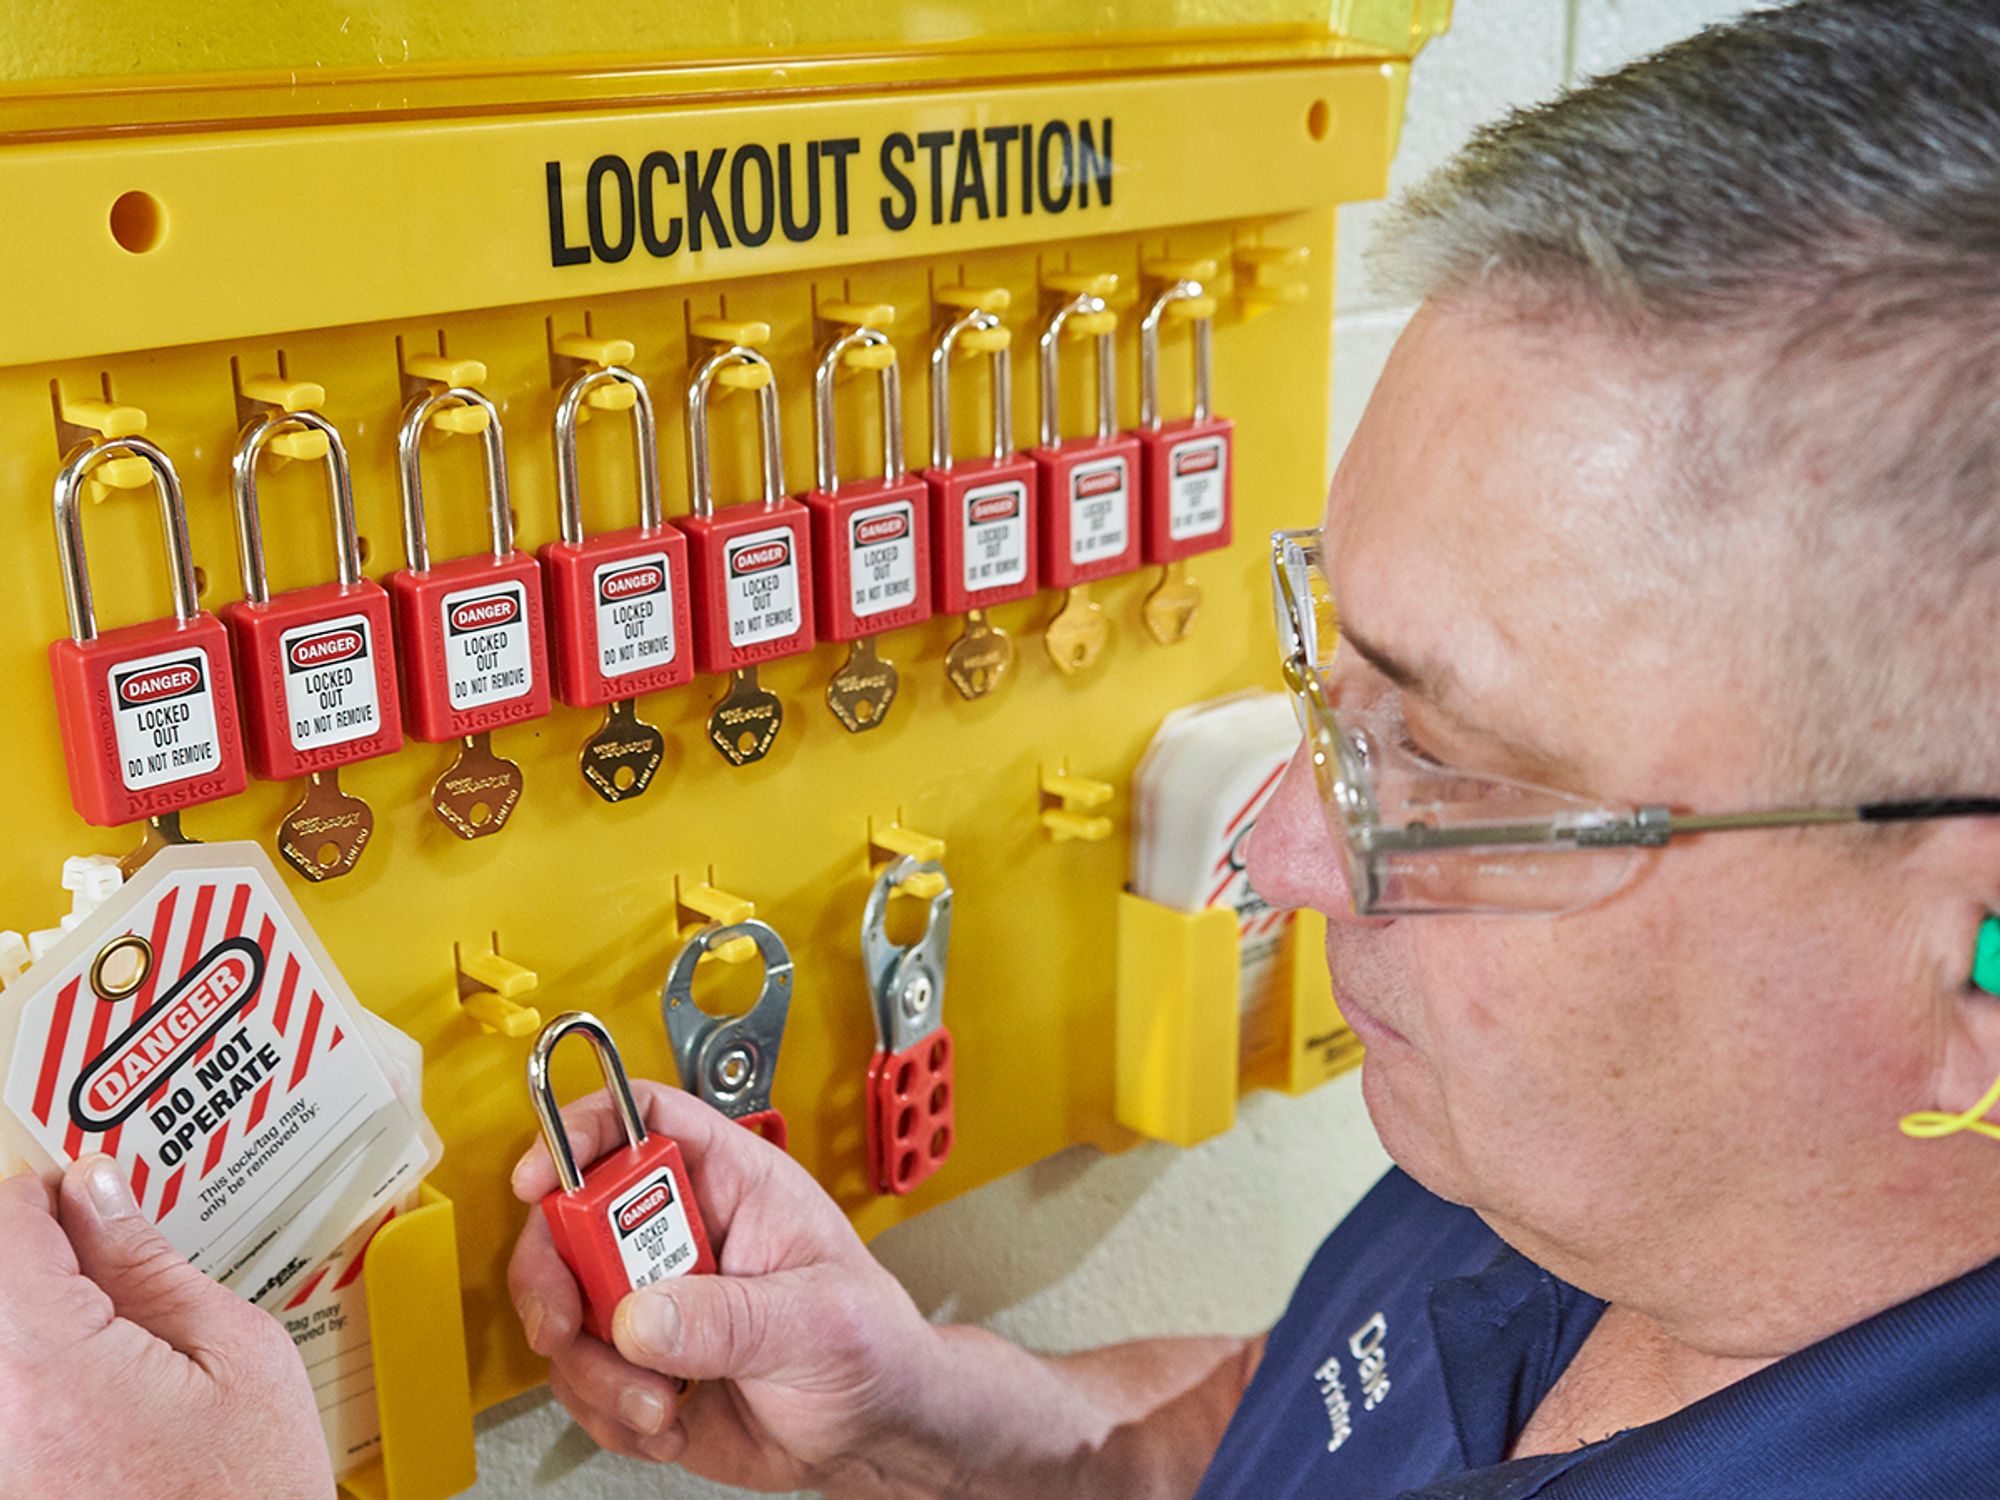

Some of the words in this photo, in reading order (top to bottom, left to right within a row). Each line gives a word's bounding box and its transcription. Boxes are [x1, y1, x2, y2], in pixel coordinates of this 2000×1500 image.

[545, 138, 860, 267] LOCKOUT
[880, 118, 1113, 231] STATION
[737, 547, 784, 568] DANGER
[607, 572, 657, 595] DANGER
[742, 574, 780, 597] LOCKED
[458, 602, 512, 625] DANGER
[613, 601, 654, 625] LOCKED
[752, 593, 772, 611] OUT
[624, 620, 646, 640] OUT
[734, 620, 745, 636] DO
[748, 615, 762, 633] NOT
[765, 608, 794, 628] REMOVE
[298, 637, 356, 661] DANGER
[464, 632, 509, 657] LOCKED
[604, 650, 616, 666] DO
[619, 644, 635, 662] NOT
[637, 635, 669, 657] REMOVE
[476, 652, 499, 672] OUT
[129, 671, 192, 697] DANGER
[305, 667, 353, 694] LOCKED
[455, 681, 467, 698] DO
[471, 676, 489, 695] NOT
[491, 668, 525, 690] REMOVE
[601, 668, 679, 698] Master
[319, 689, 344, 710] OUT
[137, 703, 190, 731] LOCKED
[296, 720, 310, 738] DO
[314, 715, 333, 734] NOT
[336, 704, 373, 728] REMOVE
[452, 701, 535, 732] Master
[153, 725, 180, 747] OUT
[129, 760, 143, 777] DO
[148, 753, 168, 772] NOT
[173, 742, 213, 766] REMOVE
[294, 737, 385, 770] Master
[126, 779, 226, 815] Master
[93, 966, 240, 1108] DANGER
[150, 1087, 195, 1135] DO
[195, 1027, 253, 1091] NOT
[158, 1042, 282, 1168] OPERATE
[198, 1176, 228, 1203] This
[227, 1126, 280, 1177] lock/tag
[278, 1098, 306, 1128] may
[200, 1194, 227, 1222] only
[227, 1176, 246, 1195] be
[246, 1122, 300, 1177] removed
[299, 1102, 321, 1124] by:
[623, 1190, 666, 1226] DANGER
[633, 1217, 670, 1251] LOCKED
[647, 1237, 667, 1261] OUT
[663, 1243, 690, 1271] REMOVE
[286, 1316, 309, 1332] /tag
[313, 1304, 340, 1321] may
[294, 1322, 326, 1346] oved
